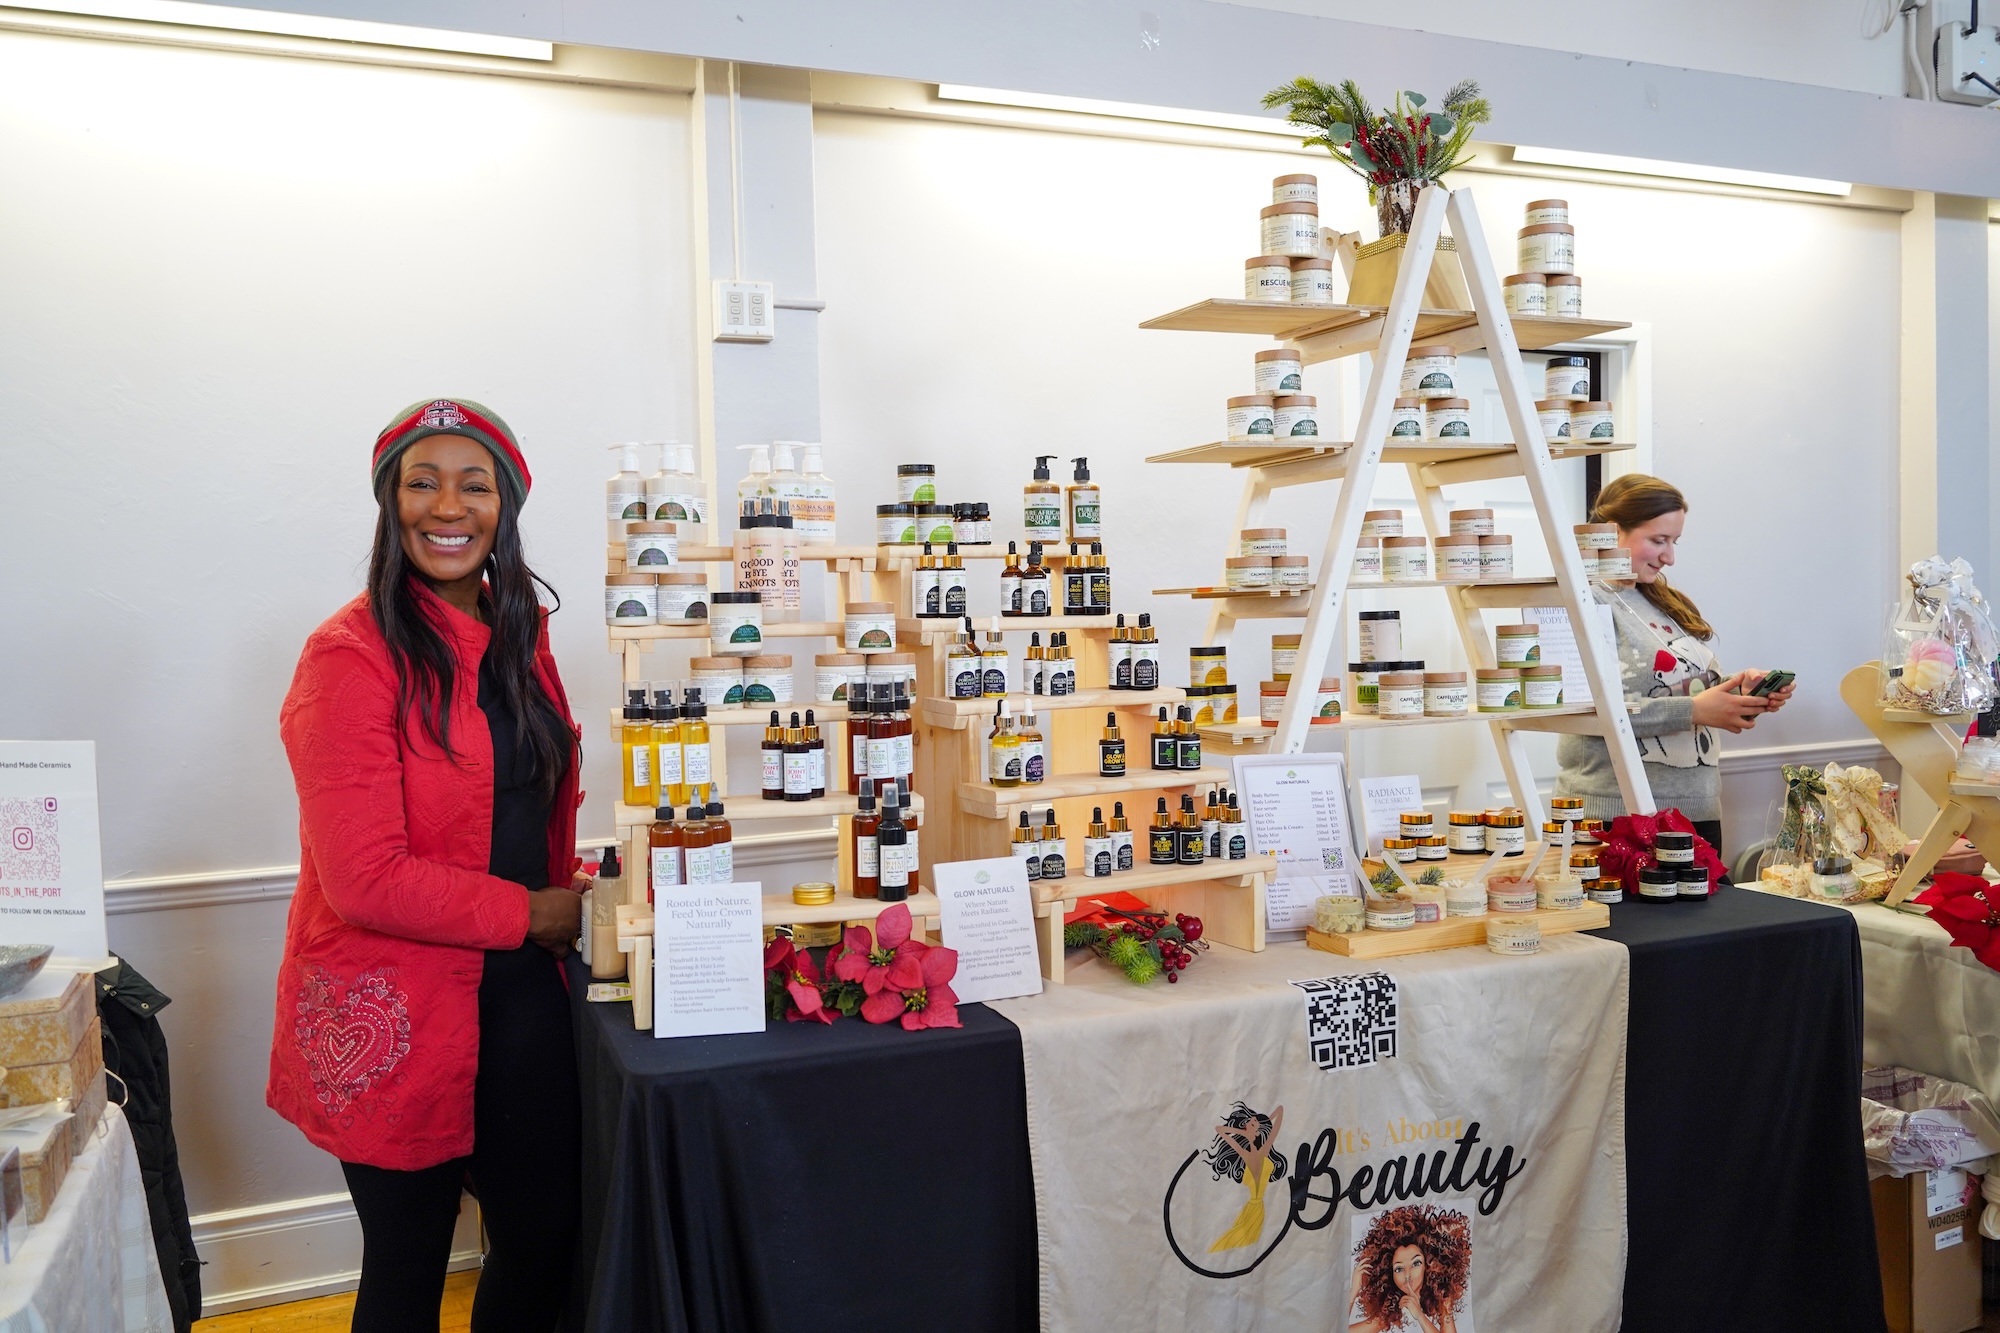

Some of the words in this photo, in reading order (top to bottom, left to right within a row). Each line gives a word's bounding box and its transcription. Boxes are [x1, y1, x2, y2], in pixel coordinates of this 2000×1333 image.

[1260, 279, 1286, 287] RESCUE
[753, 568, 768, 577] BYE
[1368, 787, 1414, 798] RADIANCE
[0, 887, 61, 898] TS_IN_THE_PORT
[954, 889, 975, 898] GLOW
[977, 886, 1015, 896] NATURALS
[666, 898, 701, 908] Rooted
[704, 898, 713, 906] in
[672, 909, 693, 919] Feed
[696, 909, 717, 918] Your
[720, 908, 752, 916] Crown
[687, 919, 733, 930] Naturally
[1335, 1127, 1372, 1156] It's
[1381, 1116, 1464, 1149] About
[1289, 1122, 1527, 1230] Beauty
[1928, 1208, 1972, 1230] WD4025BR
